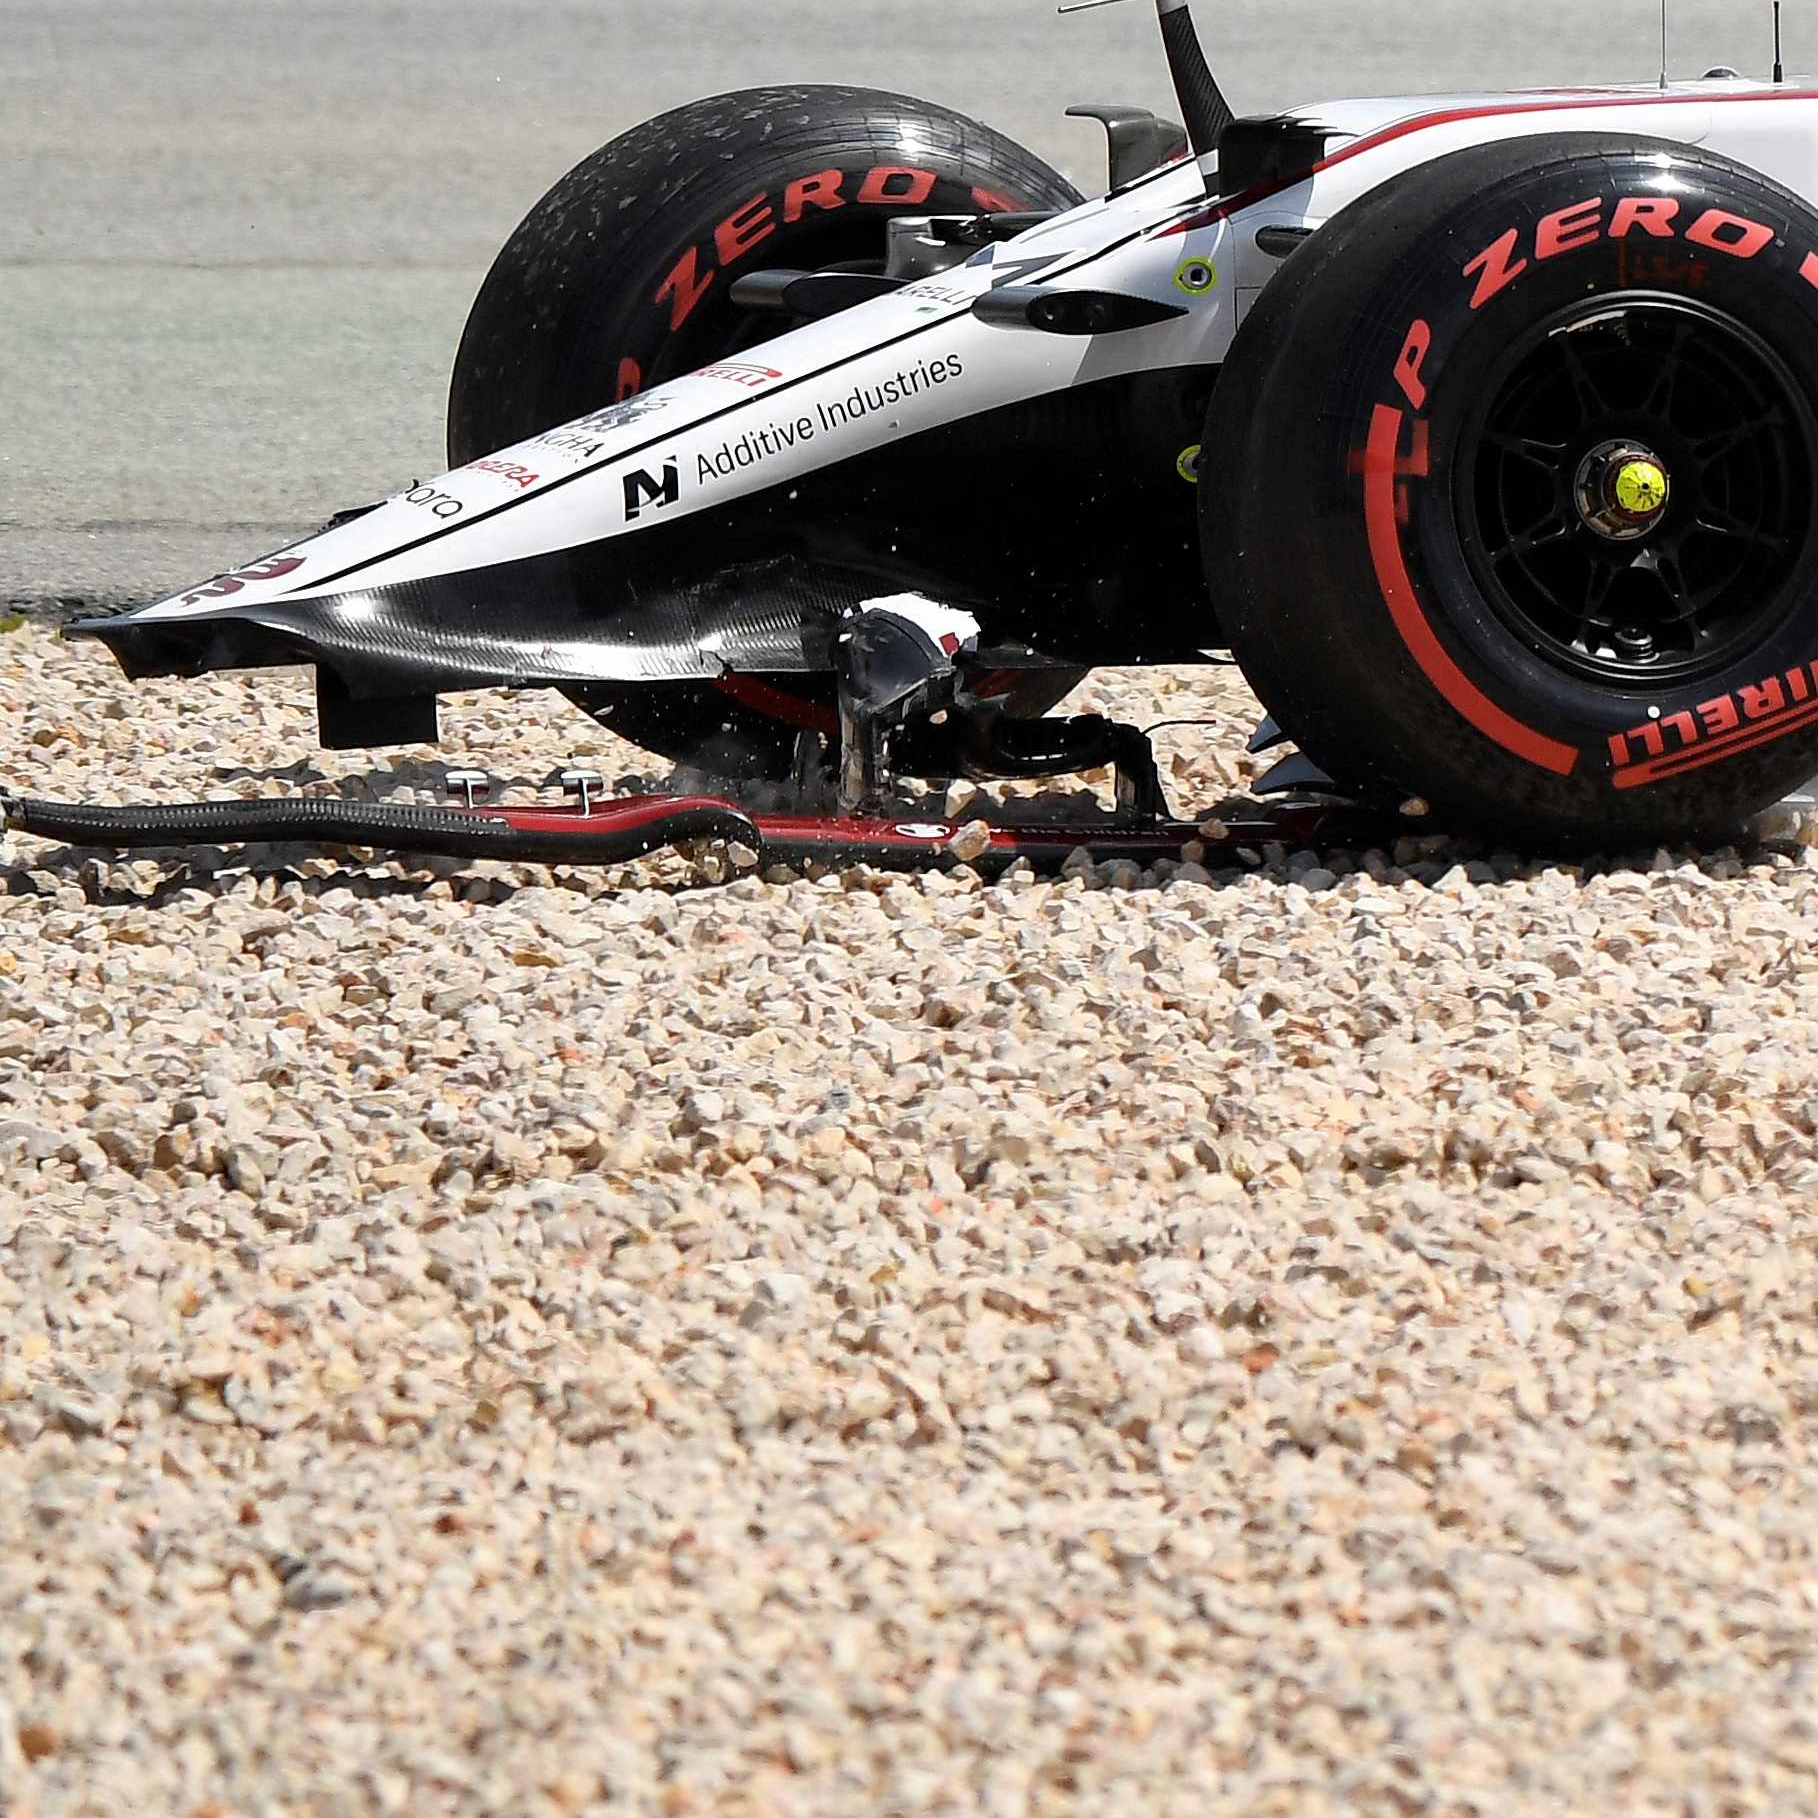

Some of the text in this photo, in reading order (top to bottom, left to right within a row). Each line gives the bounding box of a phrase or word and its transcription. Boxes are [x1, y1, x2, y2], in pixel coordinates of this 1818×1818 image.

[653, 165, 939, 332] ZERO
[1462, 195, 1778, 310] ZERO
[696, 351, 964, 482] Additive Industries
